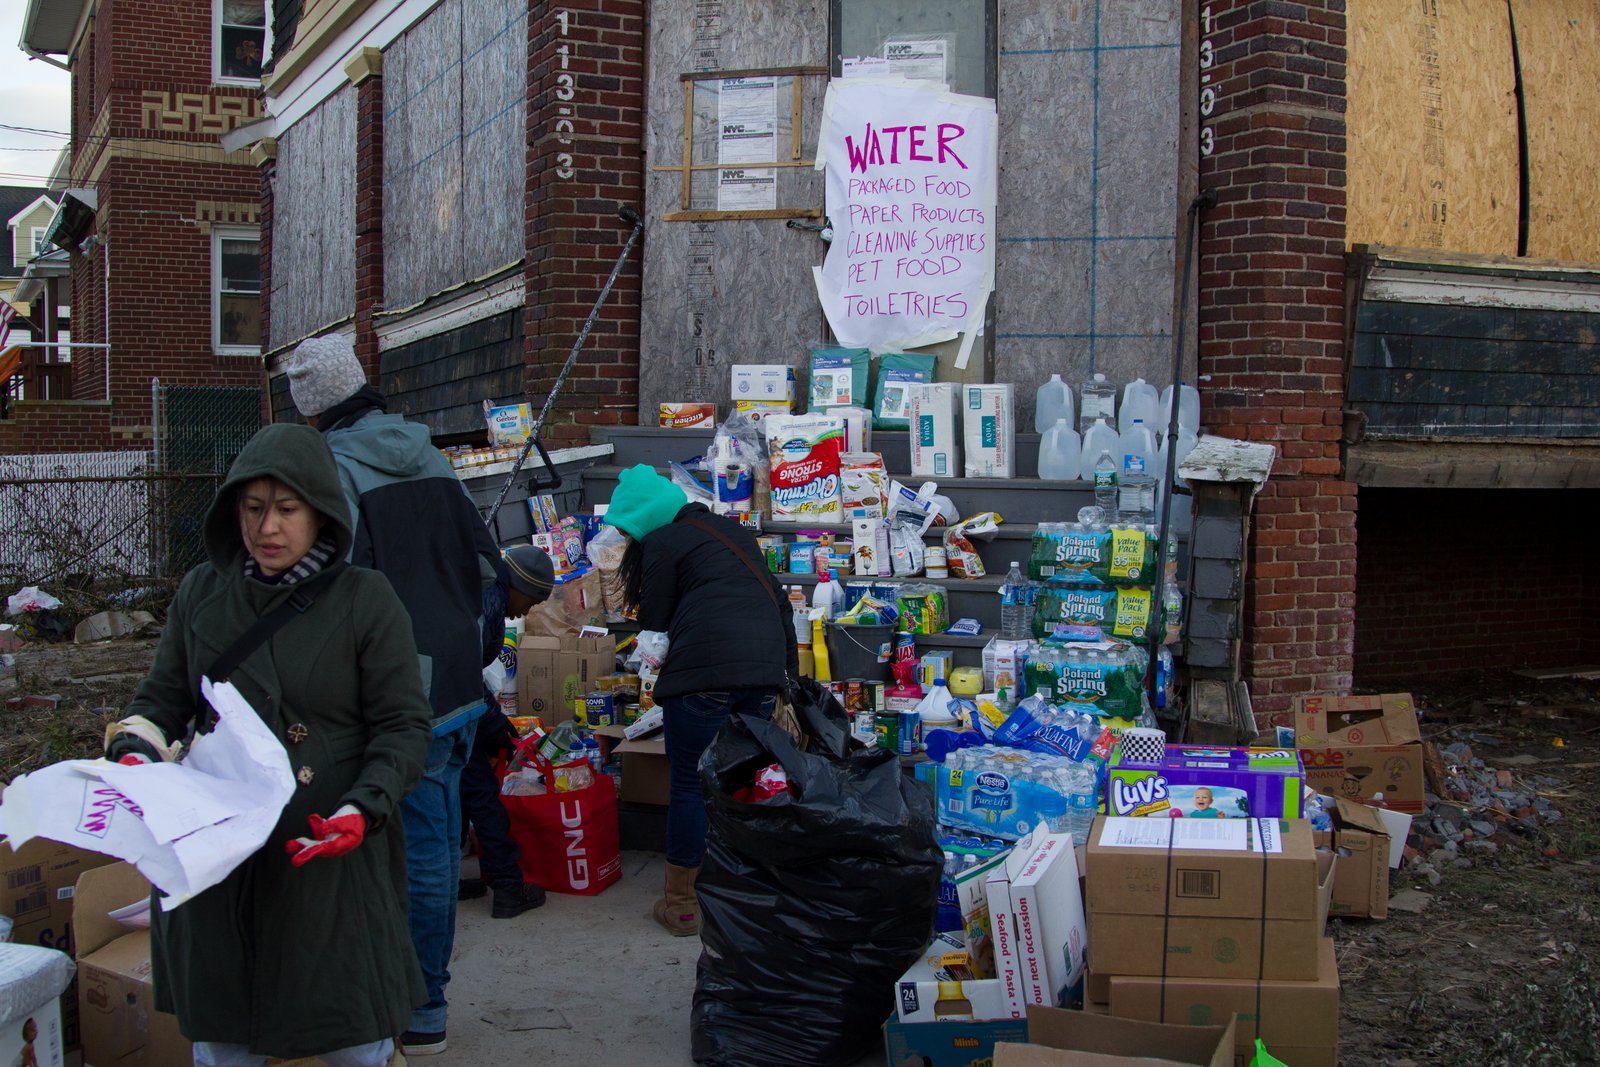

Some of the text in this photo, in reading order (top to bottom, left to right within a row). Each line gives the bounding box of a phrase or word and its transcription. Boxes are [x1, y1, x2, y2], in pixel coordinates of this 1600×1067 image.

[889, 45, 912, 54] NYC
[556, 11, 574, 179] 113-03
[724, 125, 745, 134] NYC
[845, 123, 968, 174] WATER
[723, 170, 745, 179] NYC
[849, 175, 971, 198] PACKAGED FOOD
[849, 203, 985, 225] PAPER PRODUCTS
[847, 227, 985, 258] CLEANING SUPPLIES
[848, 255, 961, 288] PET FOOD
[844, 292, 968, 318] TOILETRIES
[496, 415, 518, 423] Gerber
[674, 412, 704, 424] Kitchen
[779, 461, 823, 481] STRONG
[790, 474, 809, 484] ULTRA
[775, 473, 838, 506] Charmin
[1062, 536, 1097, 547] Poland
[1117, 537, 1141, 546] Value
[1056, 545, 1101, 563] Spring
[1118, 545, 1138, 553] Pack
[1114, 556, 1128, 566] 35
[1067, 593, 1101, 604] Poland
[1122, 596, 1146, 605] Value
[1060, 602, 1105, 620] Spring
[1122, 603, 1142, 612] Pack
[1118, 614, 1133, 625] 35
[1063, 666, 1101, 679] Poland
[1057, 677, 1107, 696] Spring
[1034, 726, 1084, 760] AQUAFINA
[1094, 744, 1108, 755] 24
[1301, 748, 1344, 766] Dole
[952, 770, 962, 779] 24
[974, 795, 1009, 807] Pure Life
[560, 799, 590, 890] GNC
[1019, 897, 1035, 954] occassion
[996, 913, 1011, 957] Seafood
[1004, 969, 1016, 998] Pasta
[1026, 957, 1040, 980] next
[903, 989, 915, 1001] 24
